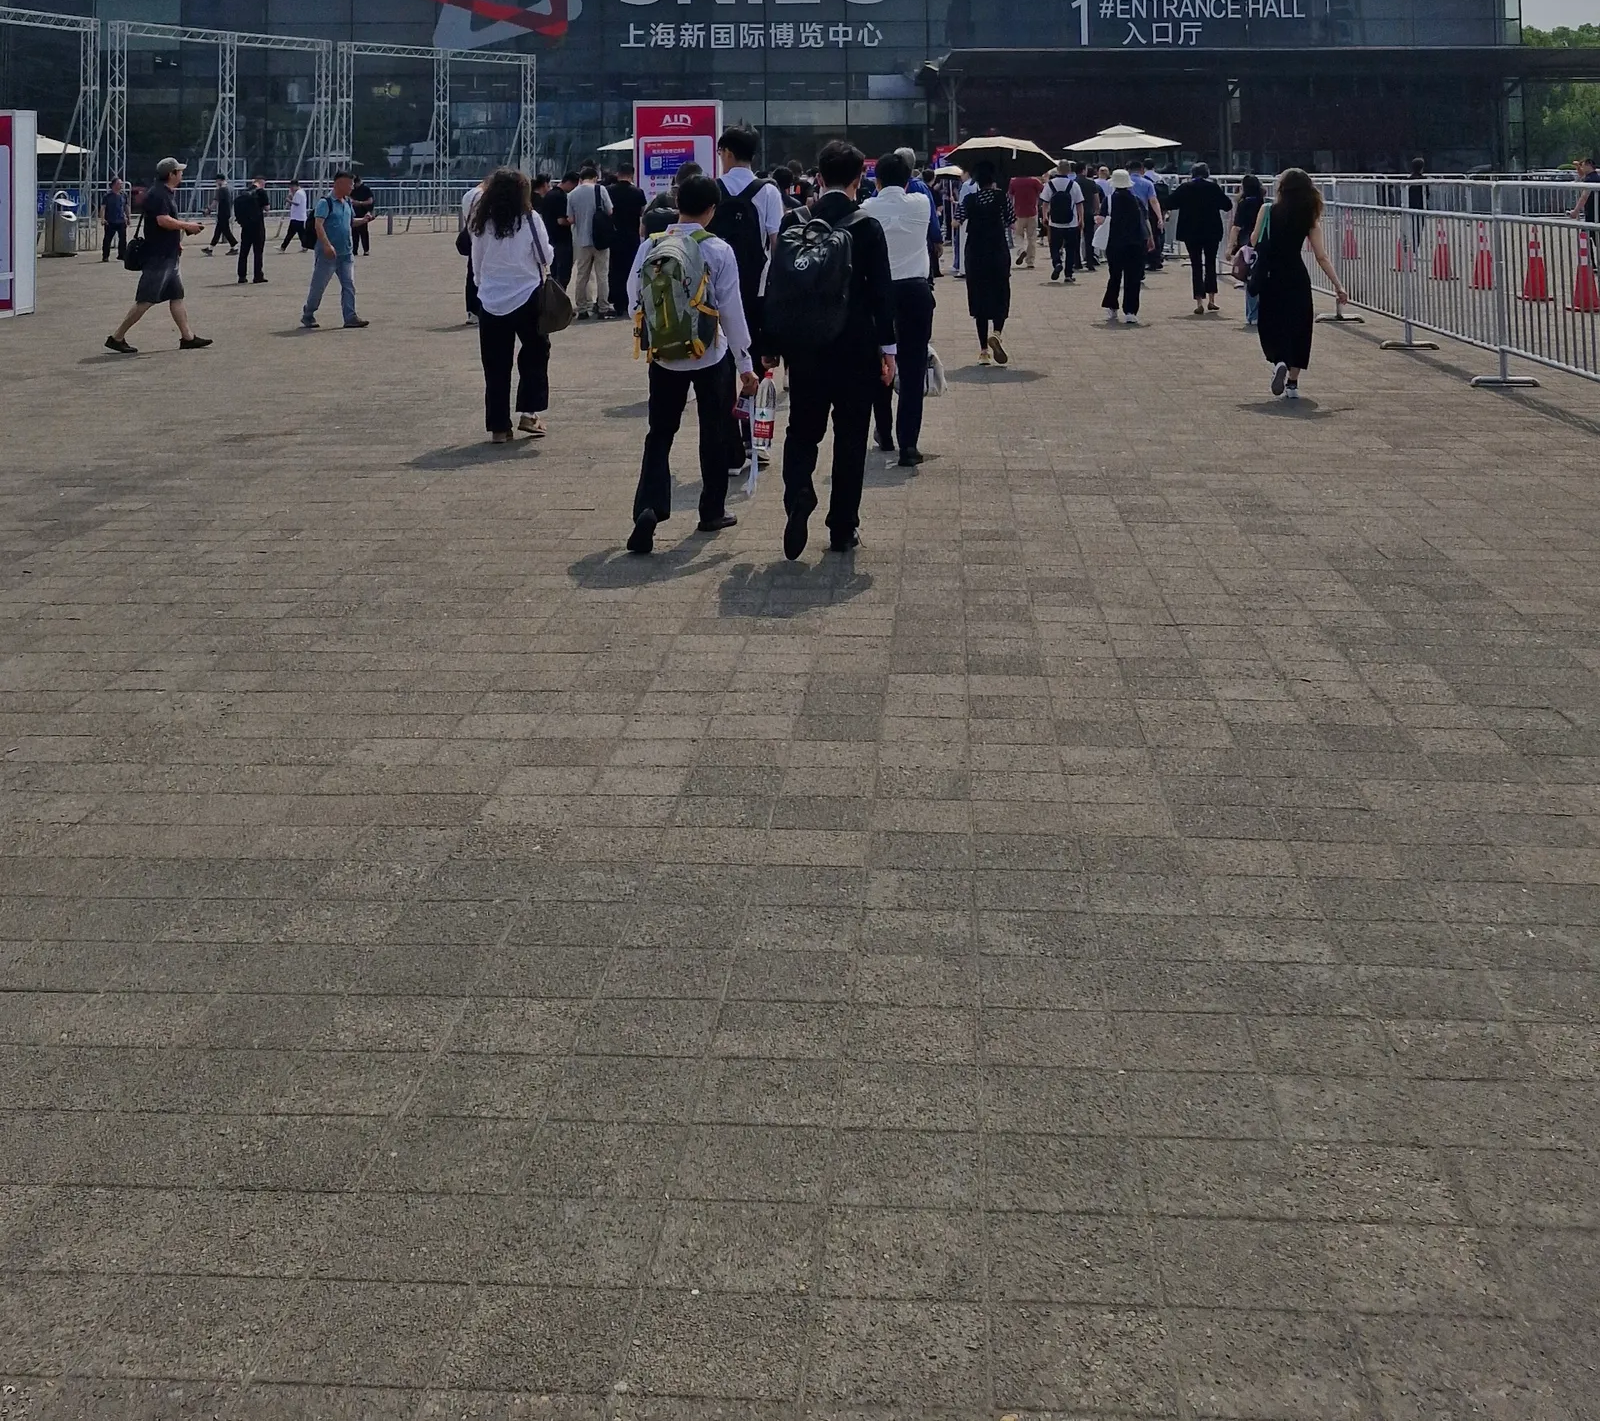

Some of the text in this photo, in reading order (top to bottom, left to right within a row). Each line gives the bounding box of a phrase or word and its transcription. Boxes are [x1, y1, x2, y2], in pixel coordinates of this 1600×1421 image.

[619, 22, 884, 49] 上海新国际博览中心
[1122, 21, 1203, 46] 入口厅
